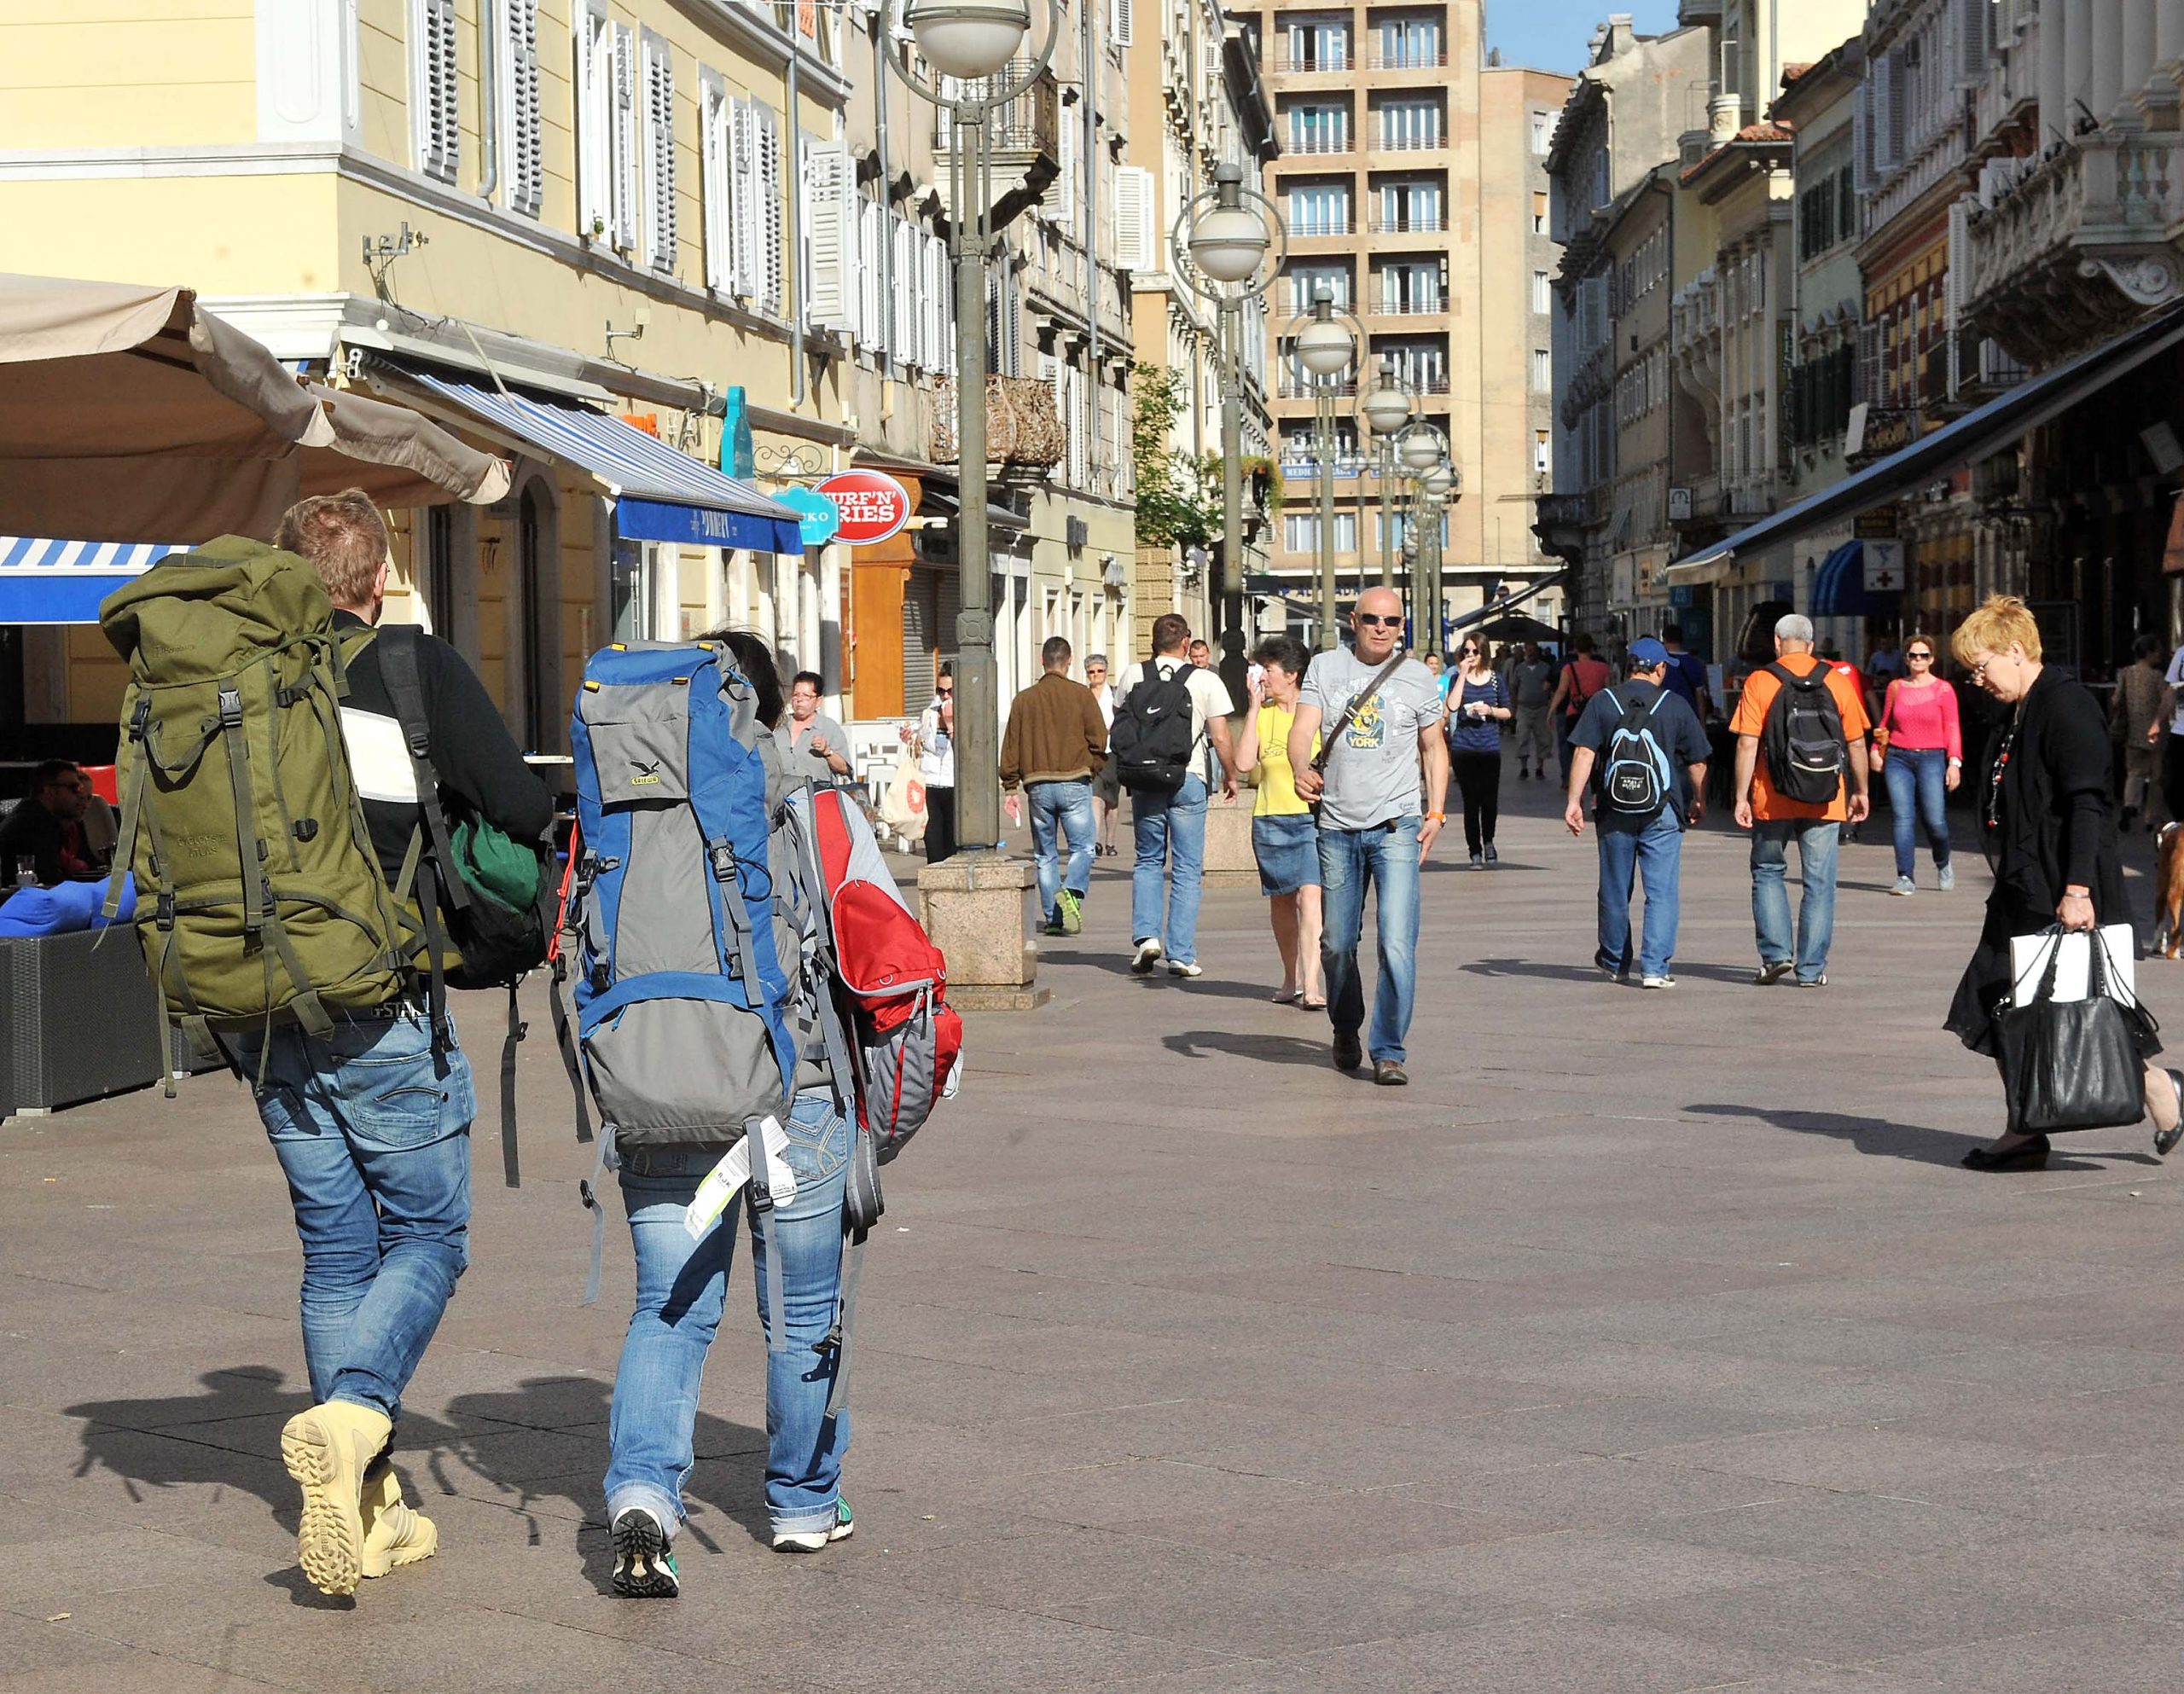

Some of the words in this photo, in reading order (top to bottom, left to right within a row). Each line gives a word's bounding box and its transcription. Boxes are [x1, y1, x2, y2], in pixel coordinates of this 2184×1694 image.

[825, 491, 896, 505] URF'N'
[839, 503, 895, 523] RIES
[1349, 736, 1380, 747] YORK
